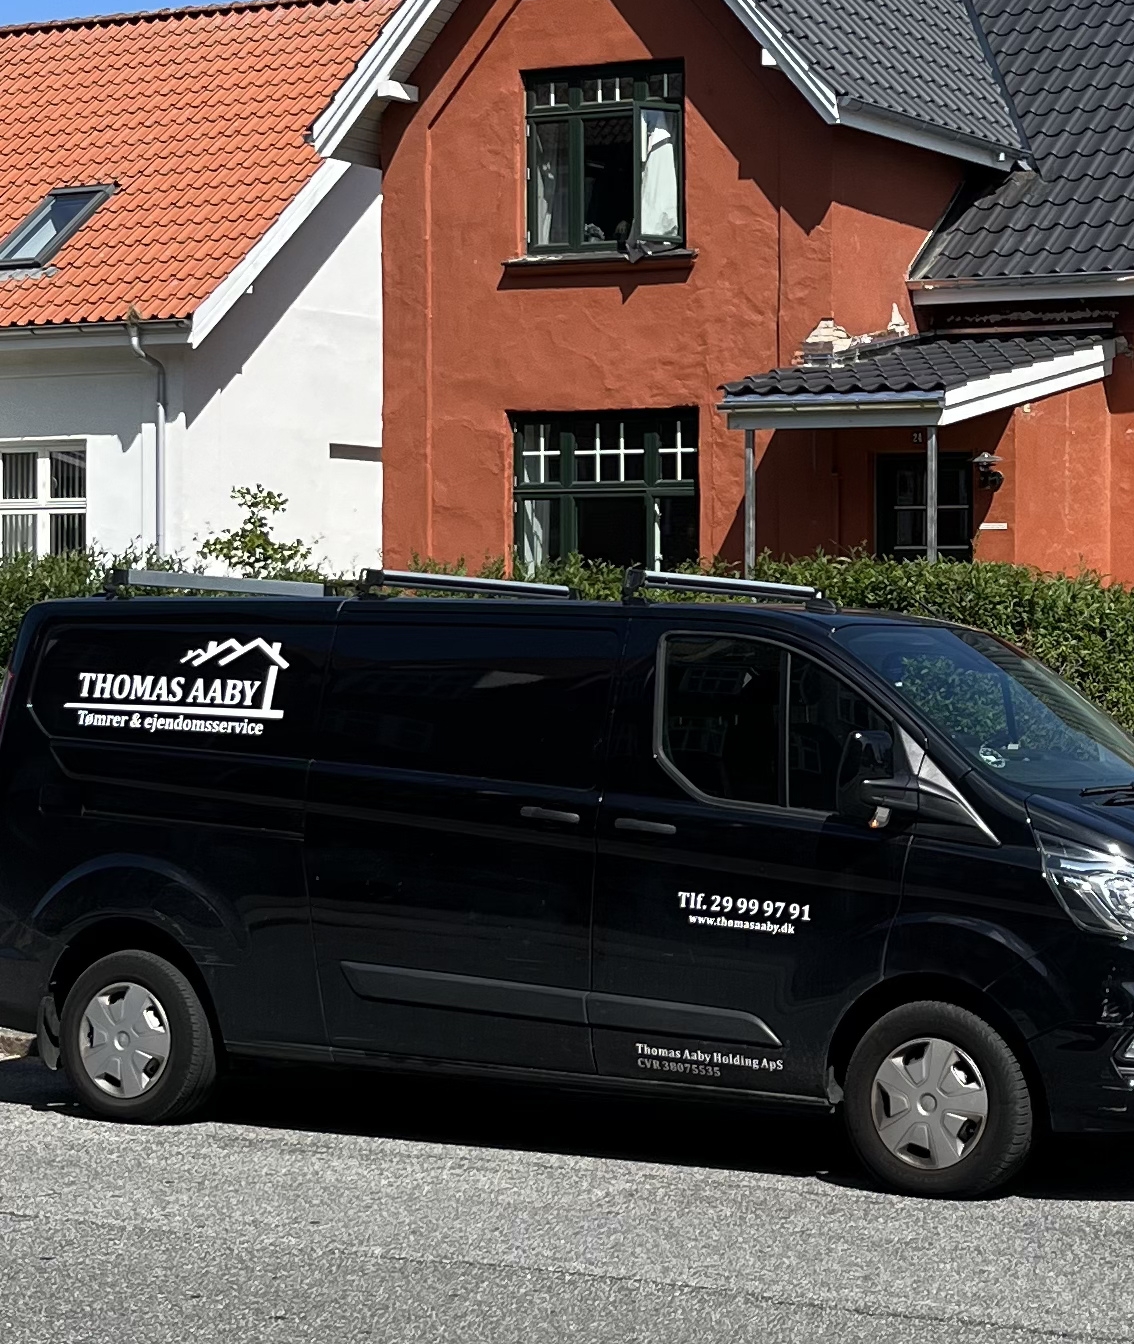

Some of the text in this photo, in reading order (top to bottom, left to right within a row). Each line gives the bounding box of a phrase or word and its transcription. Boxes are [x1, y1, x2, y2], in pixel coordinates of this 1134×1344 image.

[78, 672, 262, 706] THOMAS AABY
[78, 709, 264, 735] Tømrer & ejendomsservice
[677, 891, 811, 921] Tlf. 29 99 97 91
[688, 915, 796, 935] www.thomasaaby.dk
[635, 1043, 784, 1072] Thomas Aaby Holding ApS
[637, 1057, 661, 1070] CVR
